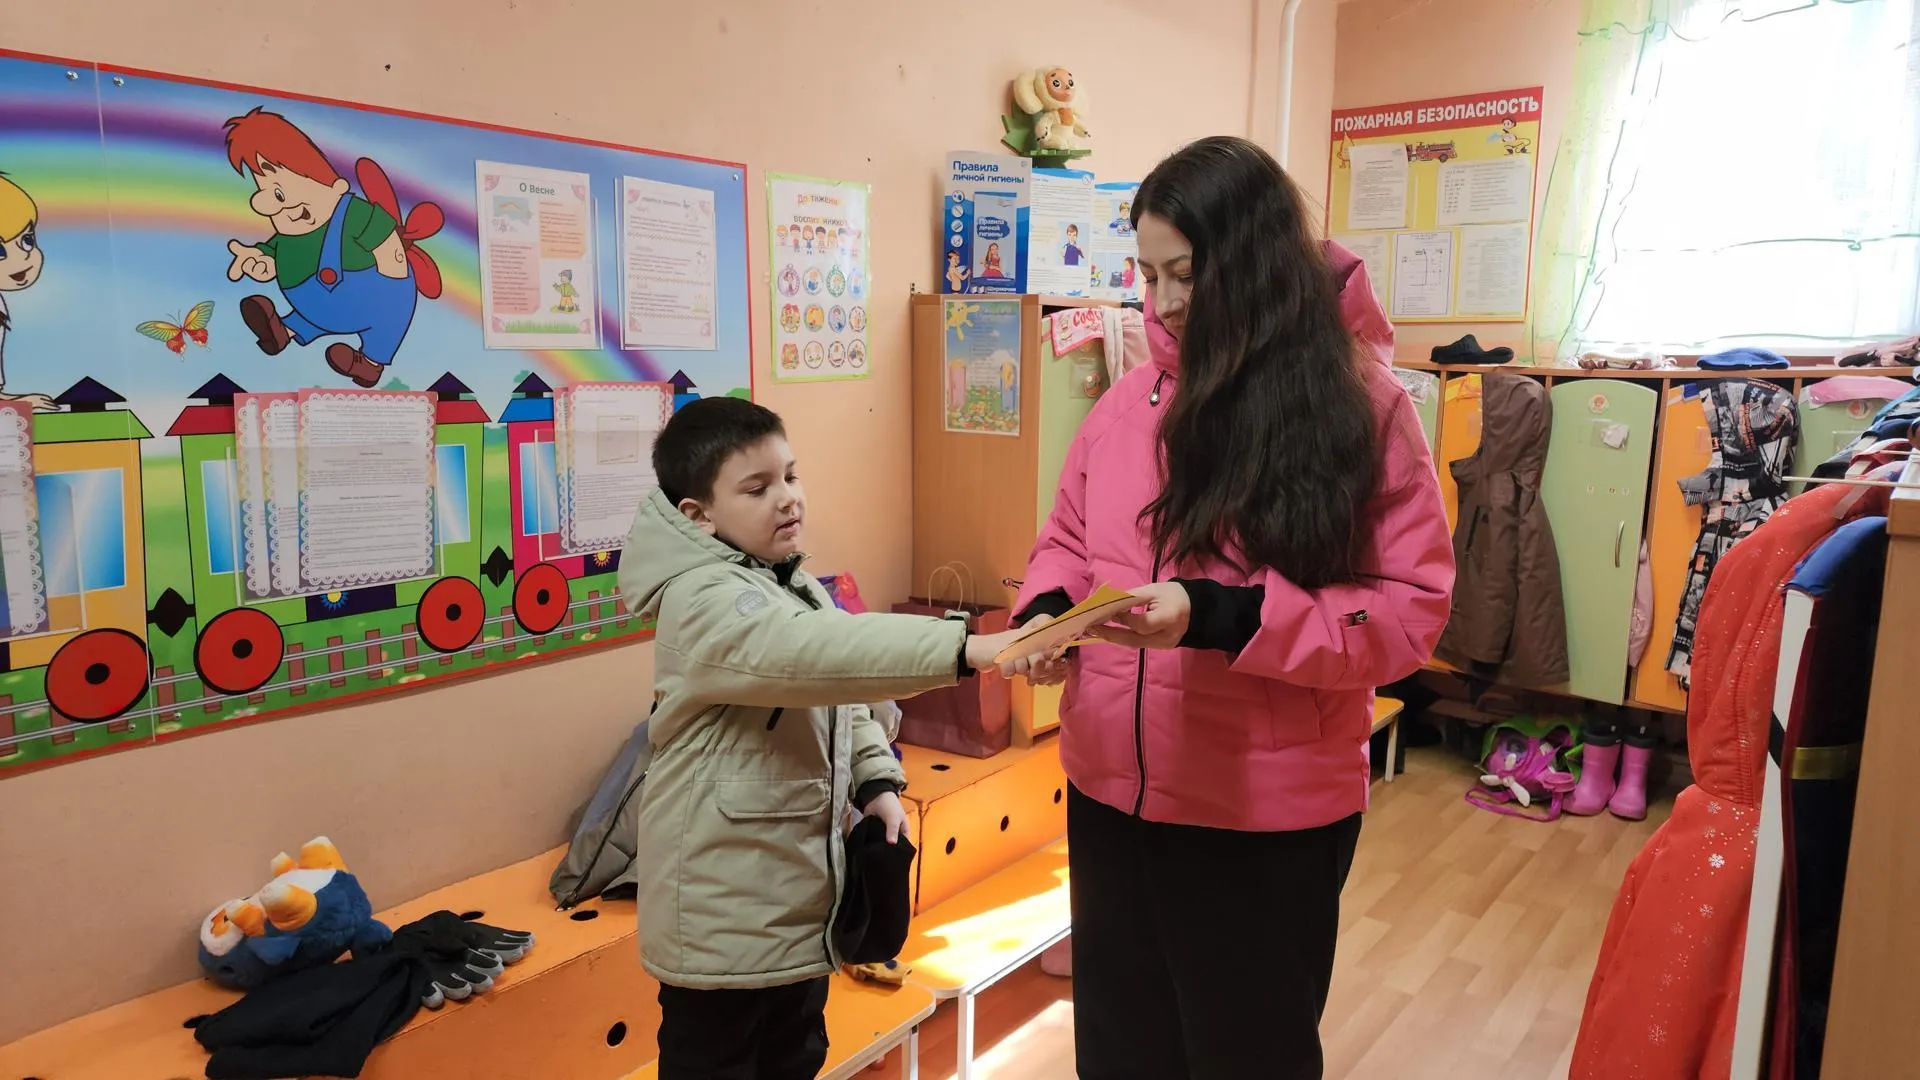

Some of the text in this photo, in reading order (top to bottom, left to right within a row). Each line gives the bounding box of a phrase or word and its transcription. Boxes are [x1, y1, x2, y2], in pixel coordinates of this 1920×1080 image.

[1334, 96, 1539, 133] ПОЖАРНАЯ БЕЗОПАСНОСТЬ
[952, 161, 999, 174] Правила
[952, 172, 1025, 184] личной гигиены
[519, 182, 555, 196] О Весне
[797, 194, 842, 206] Достижени
[793, 215, 848, 226] воспитнников
